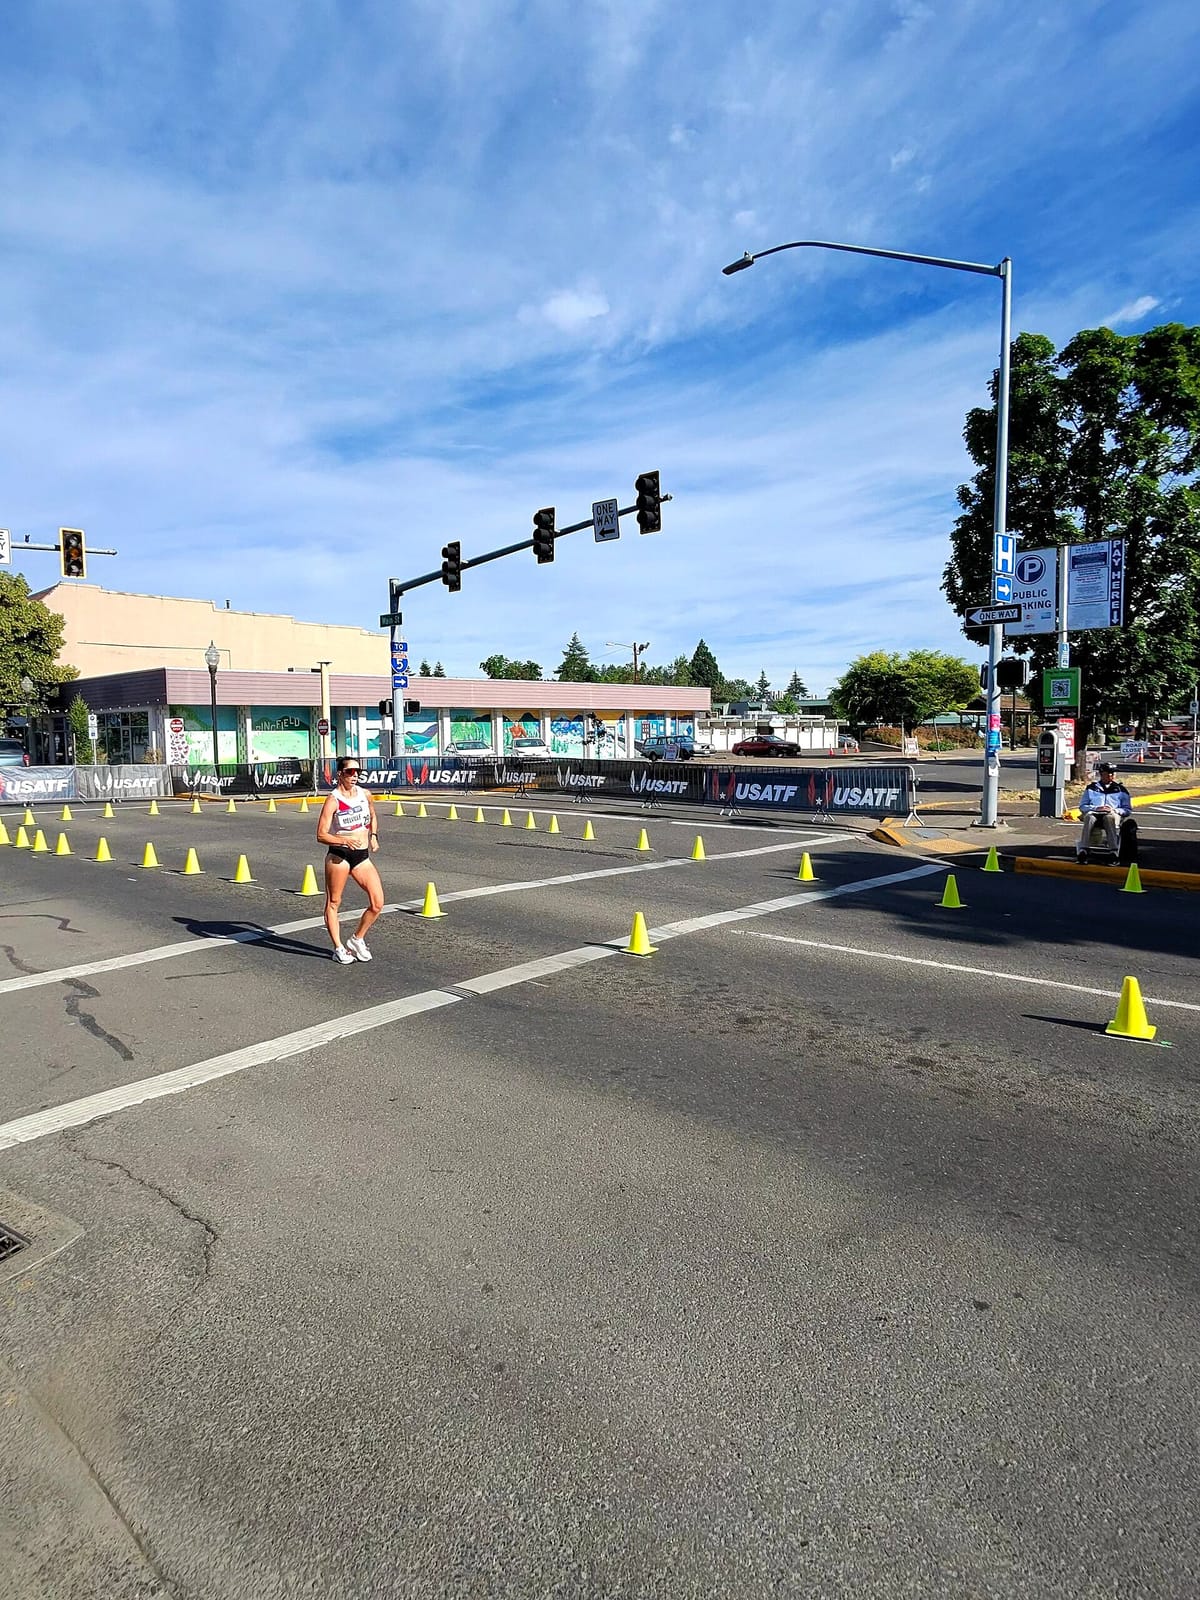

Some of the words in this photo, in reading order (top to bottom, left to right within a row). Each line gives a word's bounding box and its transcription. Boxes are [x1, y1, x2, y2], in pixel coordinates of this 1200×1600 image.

[597, 502, 614, 515] ONE
[597, 513, 614, 527] WAY
[997, 535, 1013, 573] H
[1112, 540, 1121, 566] PAY
[1024, 558, 1040, 581] P
[1012, 589, 1048, 599] PUBLIC
[1111, 571, 1121, 609] HERE
[1022, 600, 1052, 610] RKING
[979, 611, 996, 620] ONE
[997, 609, 1016, 618] WAY
[396, 658, 403, 670] 5
[113, 778, 159, 788] USATF
[200, 775, 236, 787] USATF
[268, 774, 301, 785] USATF
[358, 770, 400, 784] SATF
[429, 770, 477, 783] USATF
[506, 772, 536, 783] USATF
[570, 774, 606, 787] USATF
[6, 779, 69, 794] USATF
[646, 779, 688, 794] USATF
[735, 783, 798, 802] USATF
[833, 787, 899, 807] USATF
